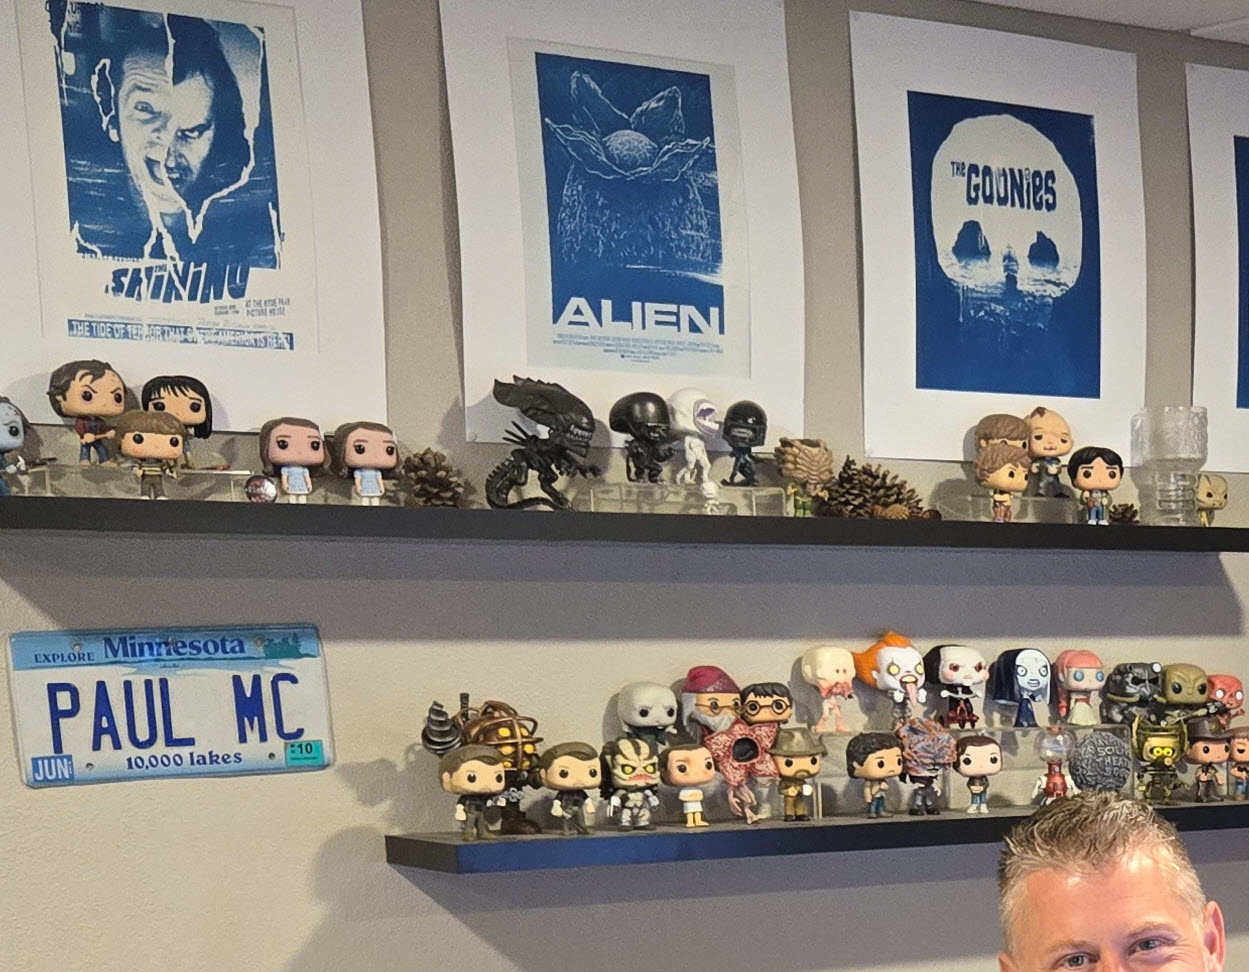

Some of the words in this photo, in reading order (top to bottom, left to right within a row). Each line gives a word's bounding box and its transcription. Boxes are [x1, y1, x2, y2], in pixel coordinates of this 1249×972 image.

[556, 297, 720, 334] ALIEN
[71, 320, 90, 337] THE
[91, 321, 113, 338] TIDE
[114, 323, 127, 339] OF
[34, 652, 96, 664] EXPLORE
[103, 635, 247, 659] Minnesota
[47, 677, 196, 754] PAUL
[232, 672, 305, 743] MC
[126, 752, 184, 770] 10,000
[189, 750, 243, 766] lakes
[297, 742, 314, 755] 10
[34, 757, 70, 781] JUN
